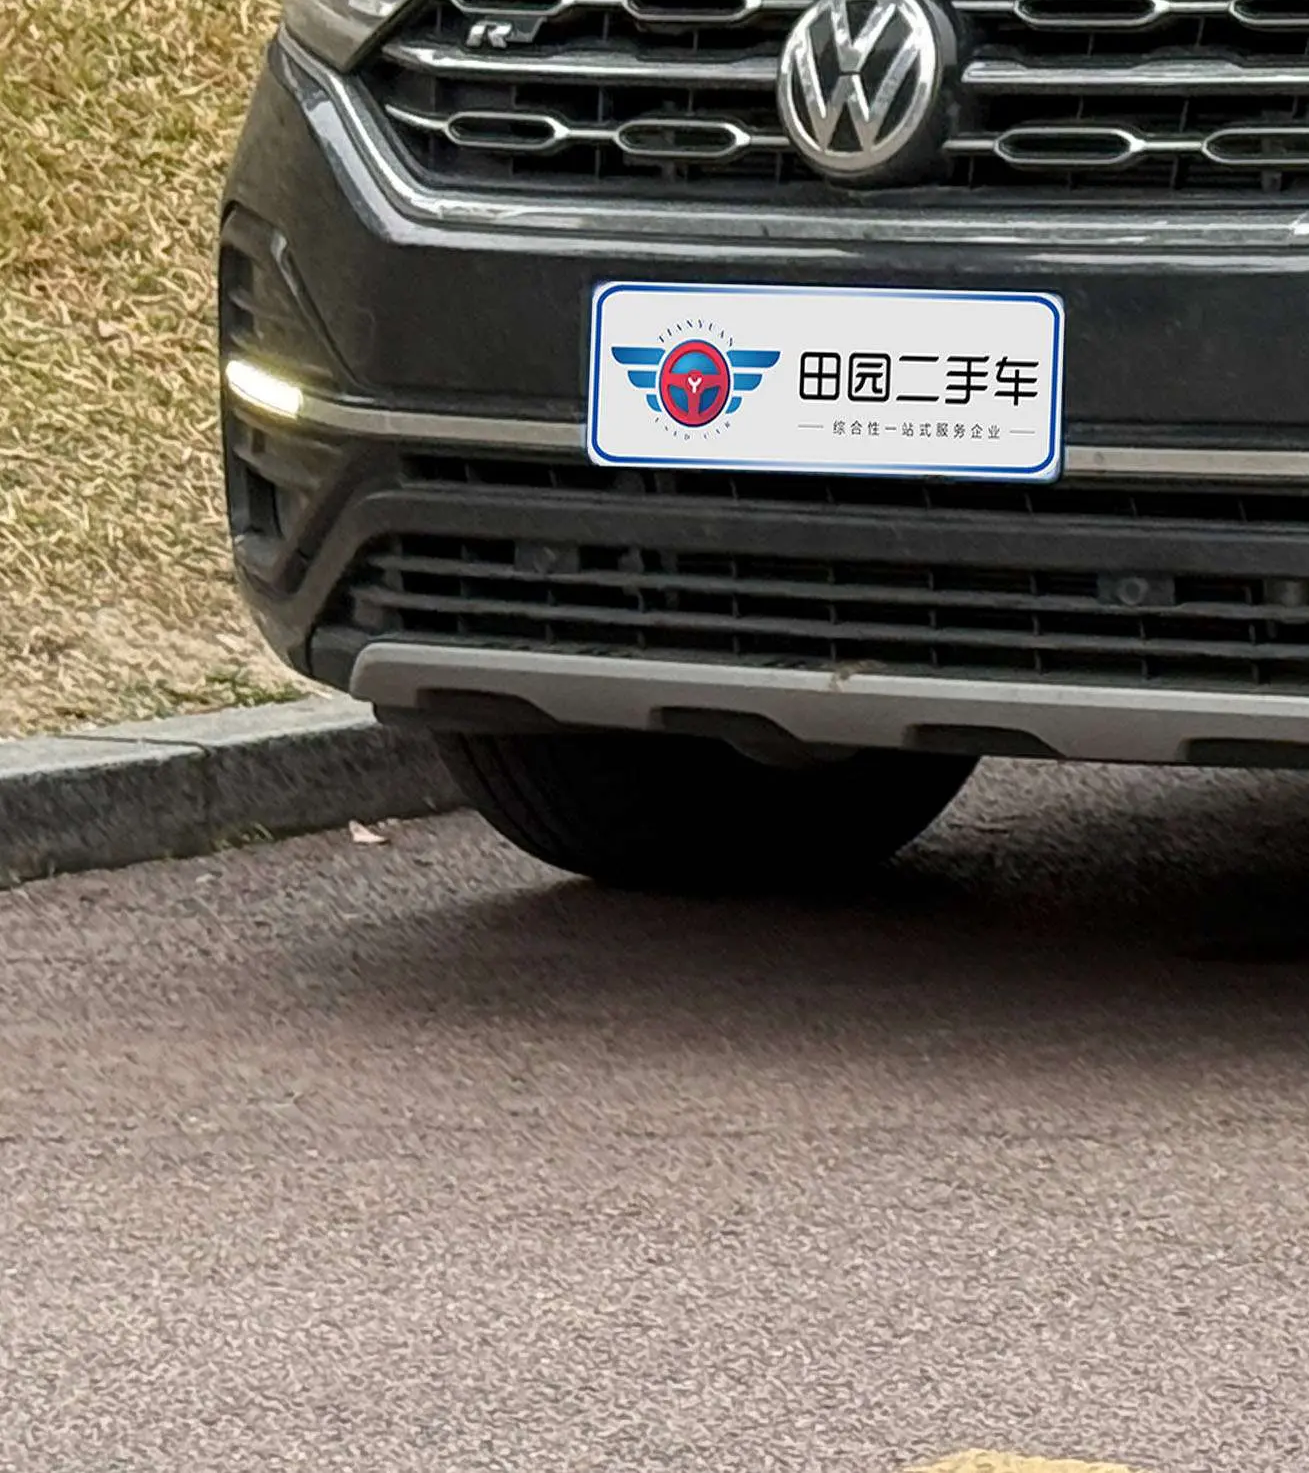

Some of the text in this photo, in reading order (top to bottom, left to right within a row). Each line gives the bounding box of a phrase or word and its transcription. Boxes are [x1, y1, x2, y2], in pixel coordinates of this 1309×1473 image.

[799, 351, 1039, 406] 田园二手车
[832, 420, 1001, 440] 综合性一站式服务企业
